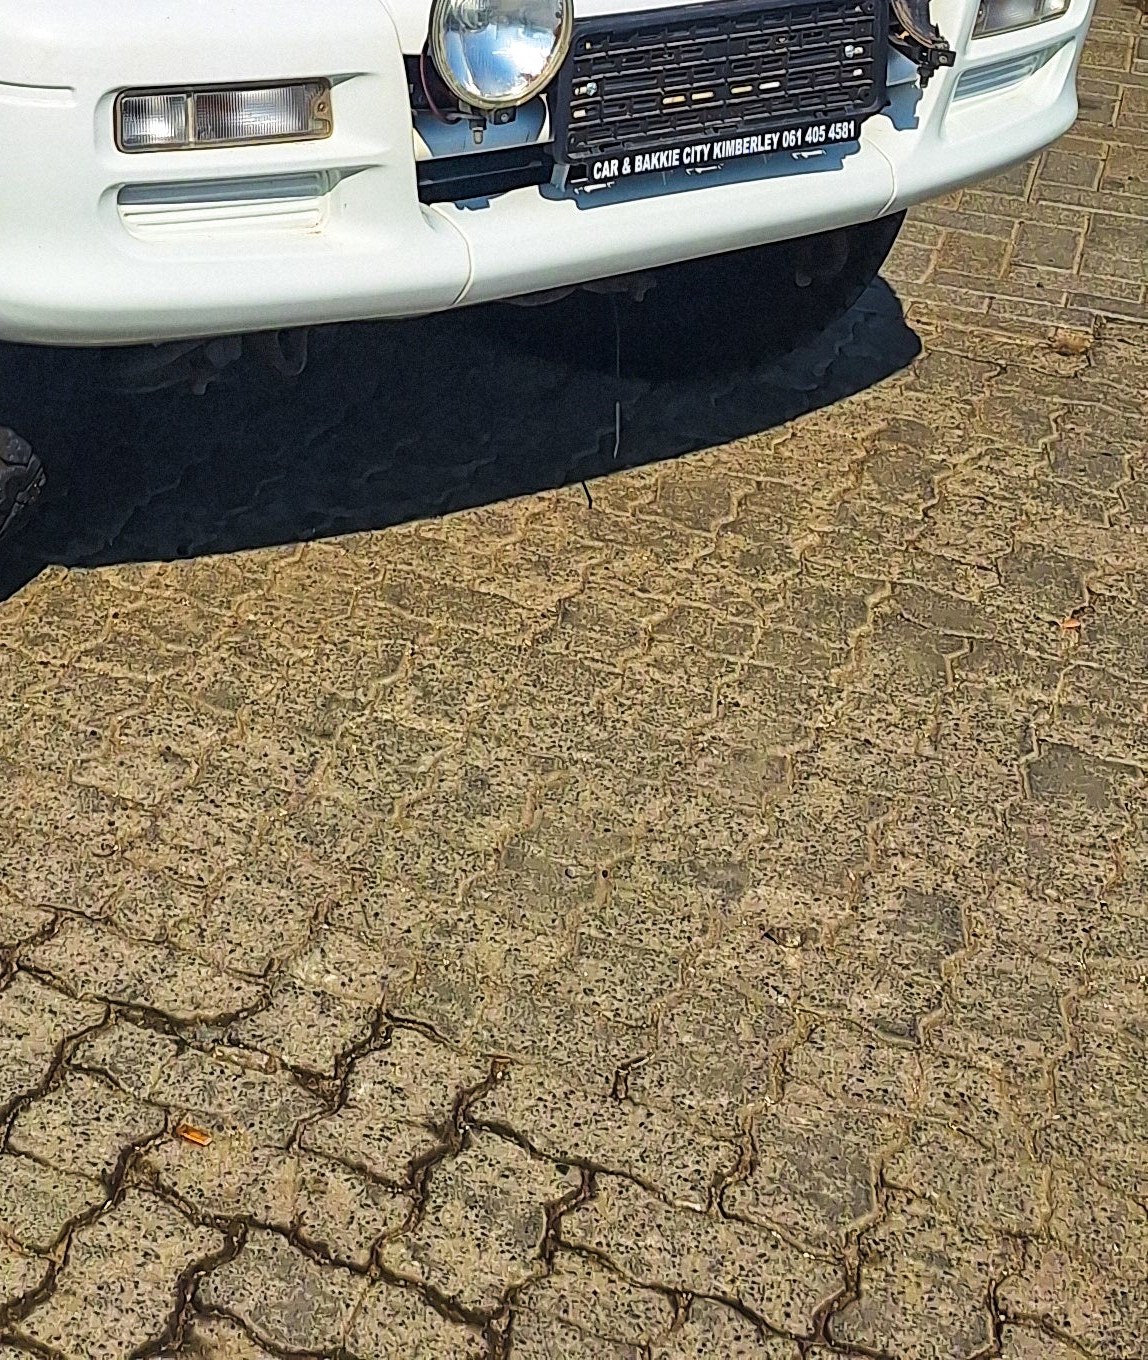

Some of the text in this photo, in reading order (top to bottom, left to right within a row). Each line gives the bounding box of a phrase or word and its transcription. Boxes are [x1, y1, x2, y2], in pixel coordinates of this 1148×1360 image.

[593, 120, 856, 180] CAR & BAKKIE CITY KIMBERLEY 061 405 4581
